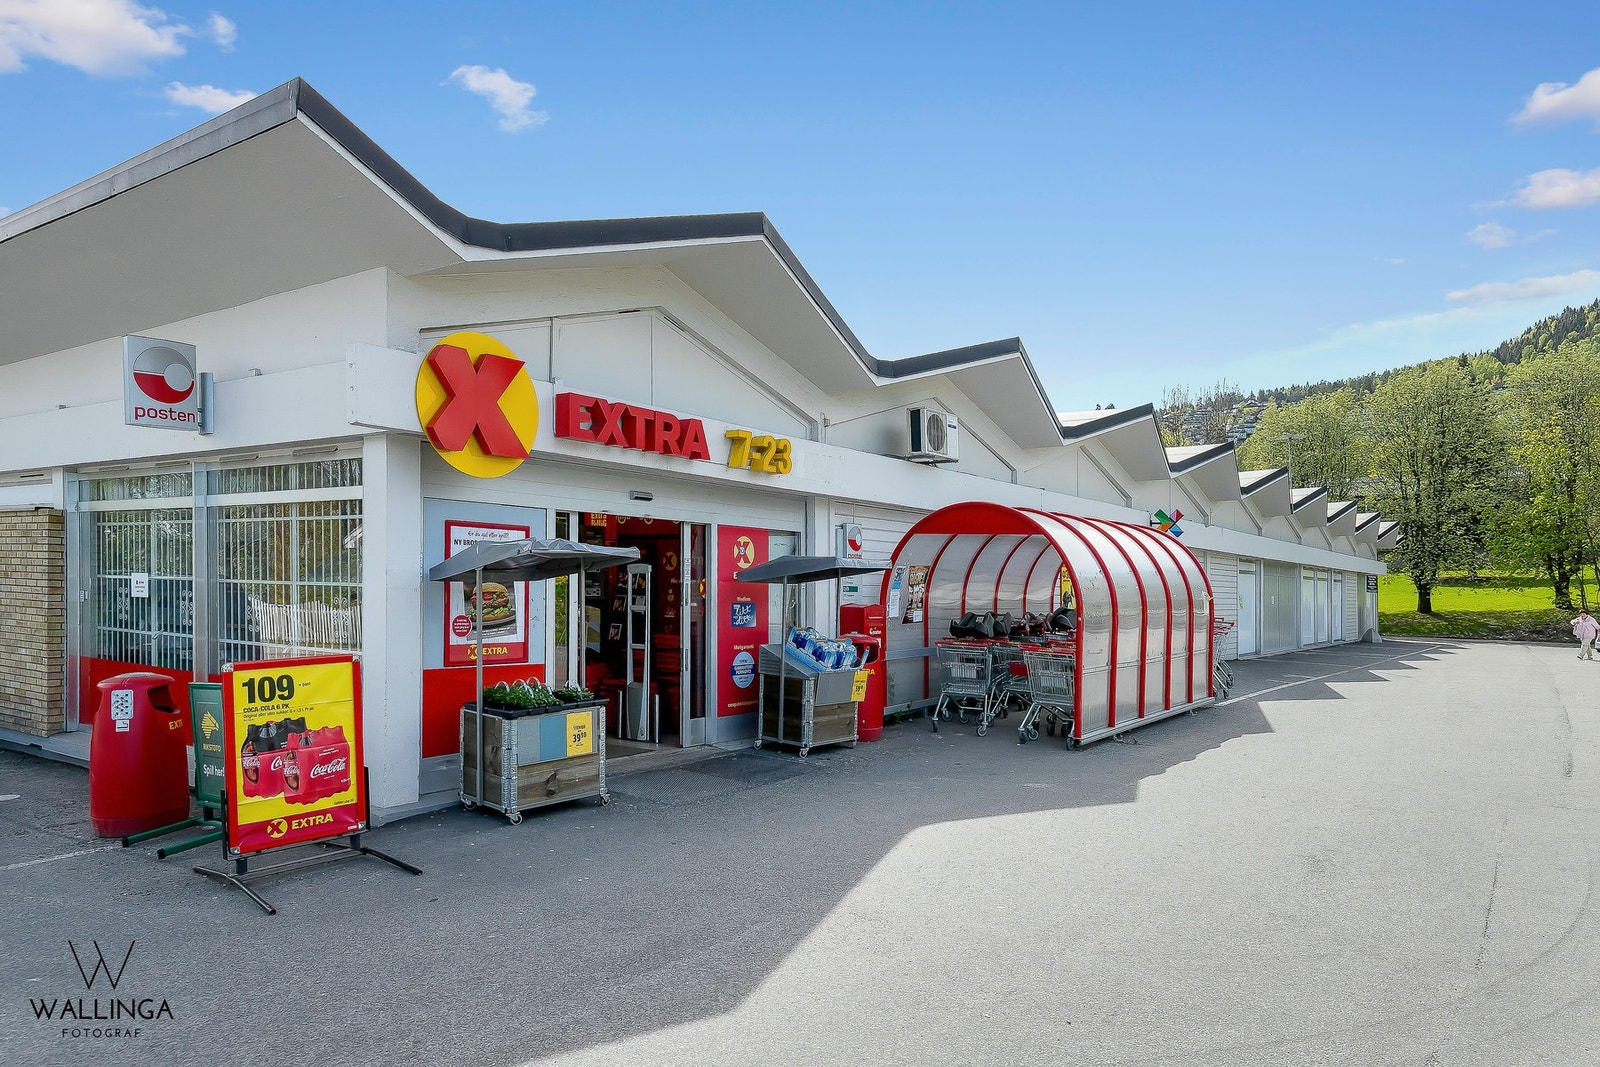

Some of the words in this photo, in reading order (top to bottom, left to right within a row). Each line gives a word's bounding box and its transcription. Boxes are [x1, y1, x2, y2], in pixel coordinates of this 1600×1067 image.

[134, 406, 196, 423] posten
[555, 393, 710, 460] EXTRA
[725, 429, 793, 475] 7-23
[482, 646, 508, 655] EXTRA
[242, 675, 295, 704] 109
[203, 764, 214, 777] Spill
[291, 813, 334, 830] EXTRA
